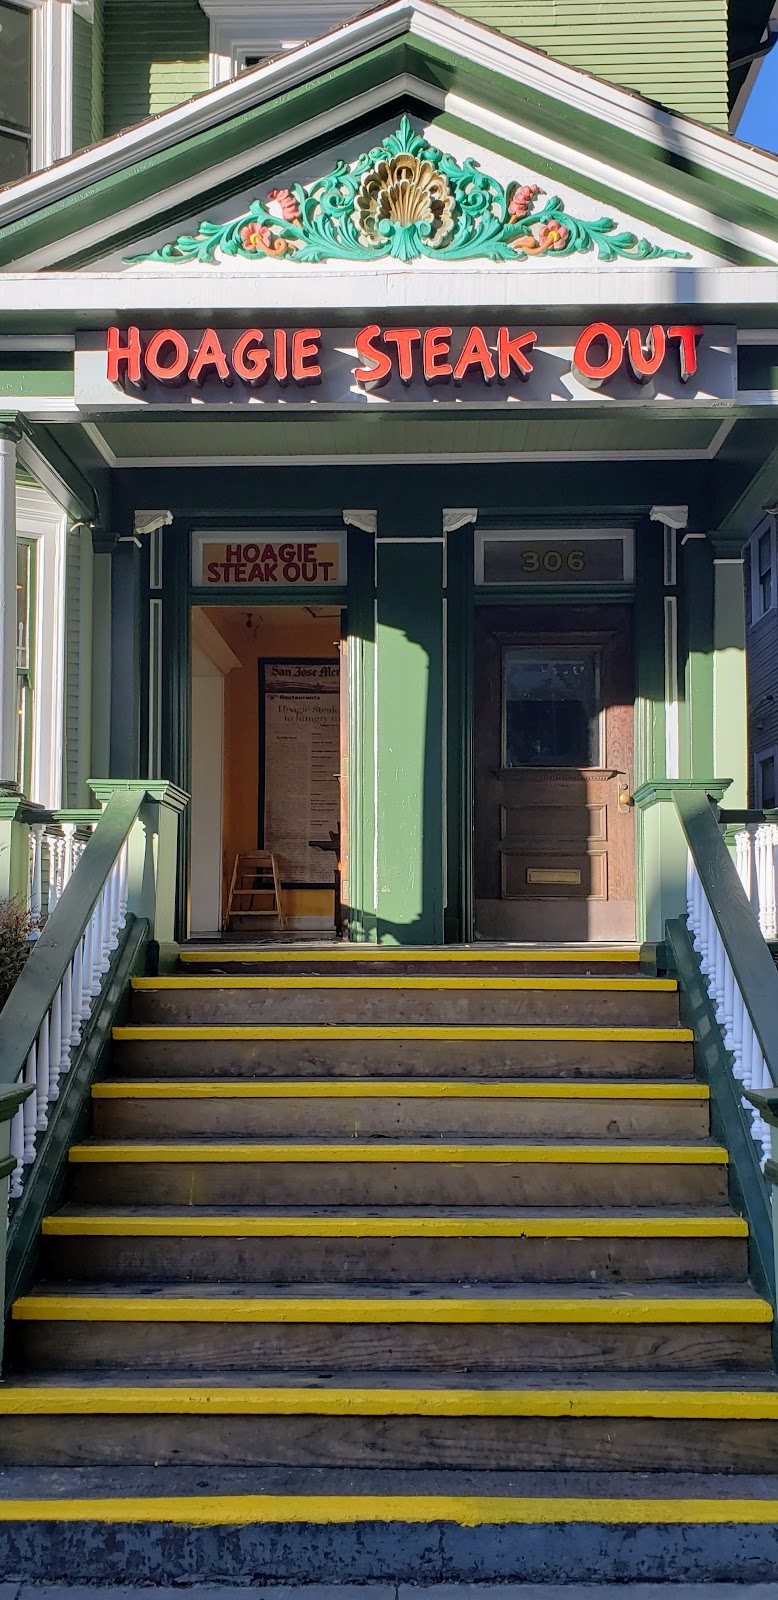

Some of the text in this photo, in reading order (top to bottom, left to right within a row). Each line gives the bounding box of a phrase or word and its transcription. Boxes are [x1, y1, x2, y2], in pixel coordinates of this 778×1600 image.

[106, 322, 704, 384] HOAGIE STEAK OUT
[226, 543, 318, 563] HOAGIE
[520, 549, 586, 573] 306
[207, 562, 334, 582] STEAK OUT
[271, 665, 292, 677] San
[293, 666, 318, 678] Jose
[278, 705, 338, 715] Hoagie Steak
[296, 714, 329, 724] hungry
